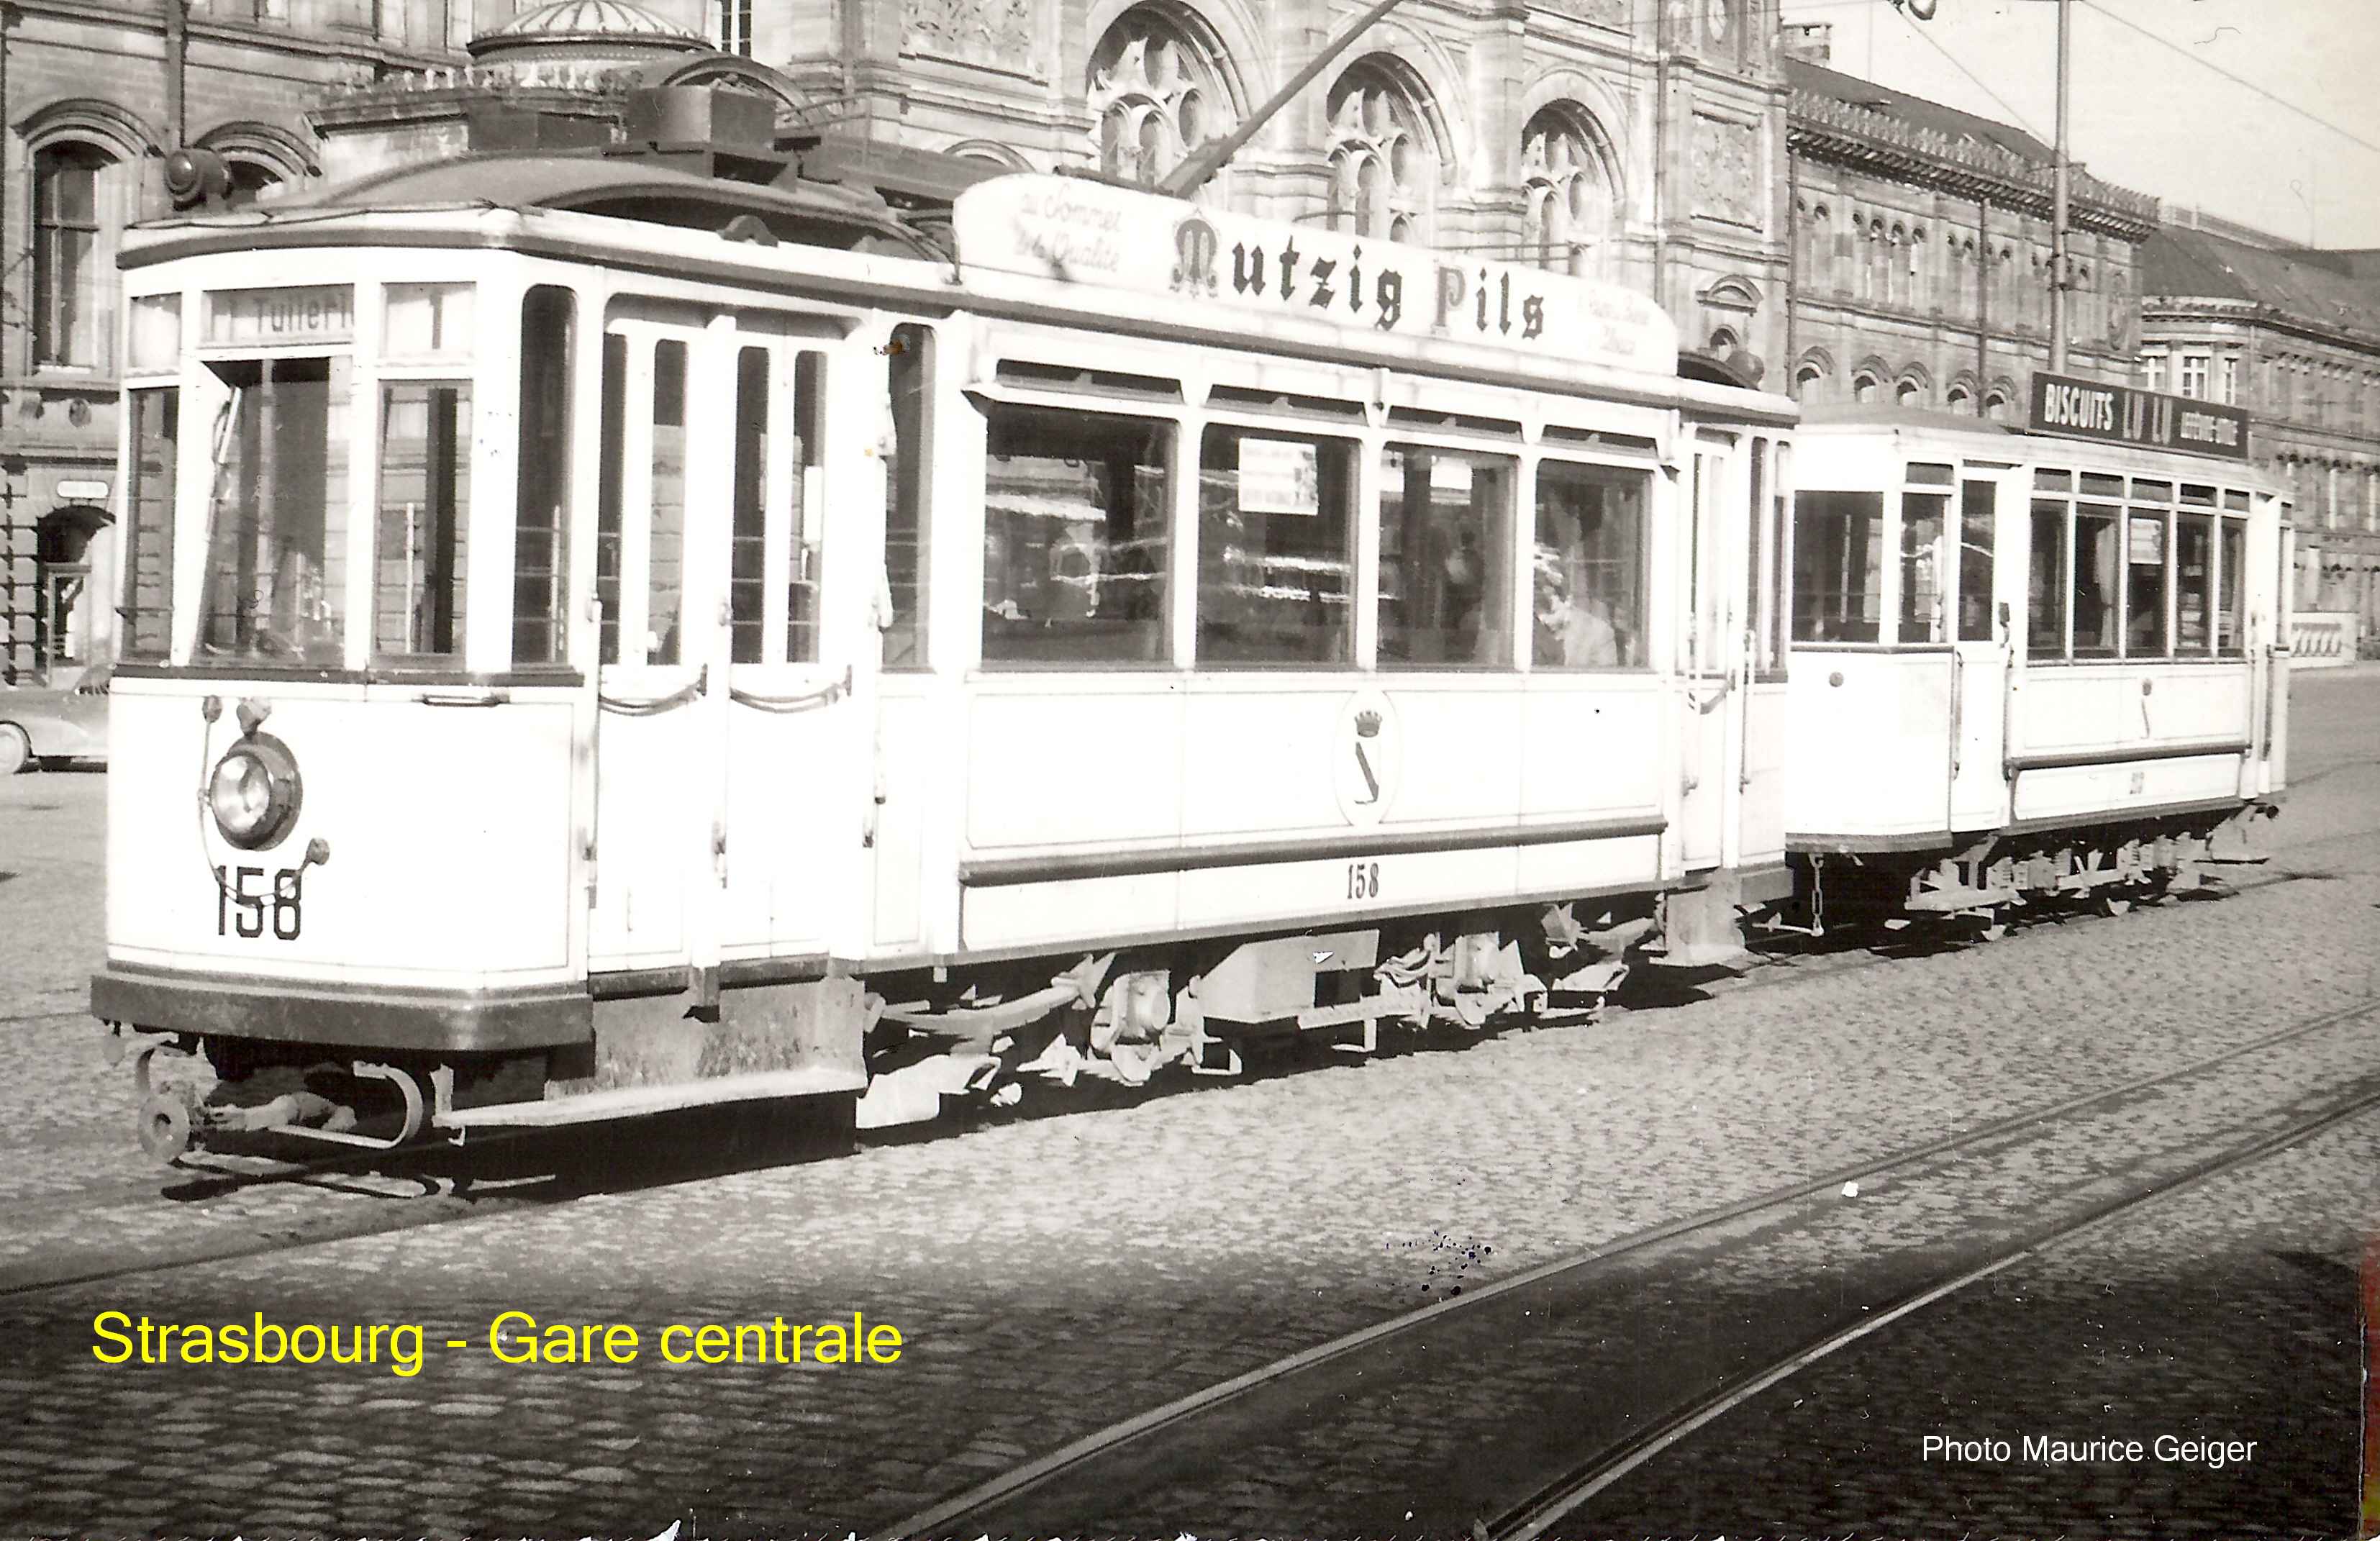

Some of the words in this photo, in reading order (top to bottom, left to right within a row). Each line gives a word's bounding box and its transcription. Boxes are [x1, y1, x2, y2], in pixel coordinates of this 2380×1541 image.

[1169, 210, 1402, 331] Mutzig
[1430, 256, 1545, 340] Pils
[2044, 383, 2113, 431] BISCUITS
[217, 865, 302, 941] 158
[1348, 863, 1379, 899] 158
